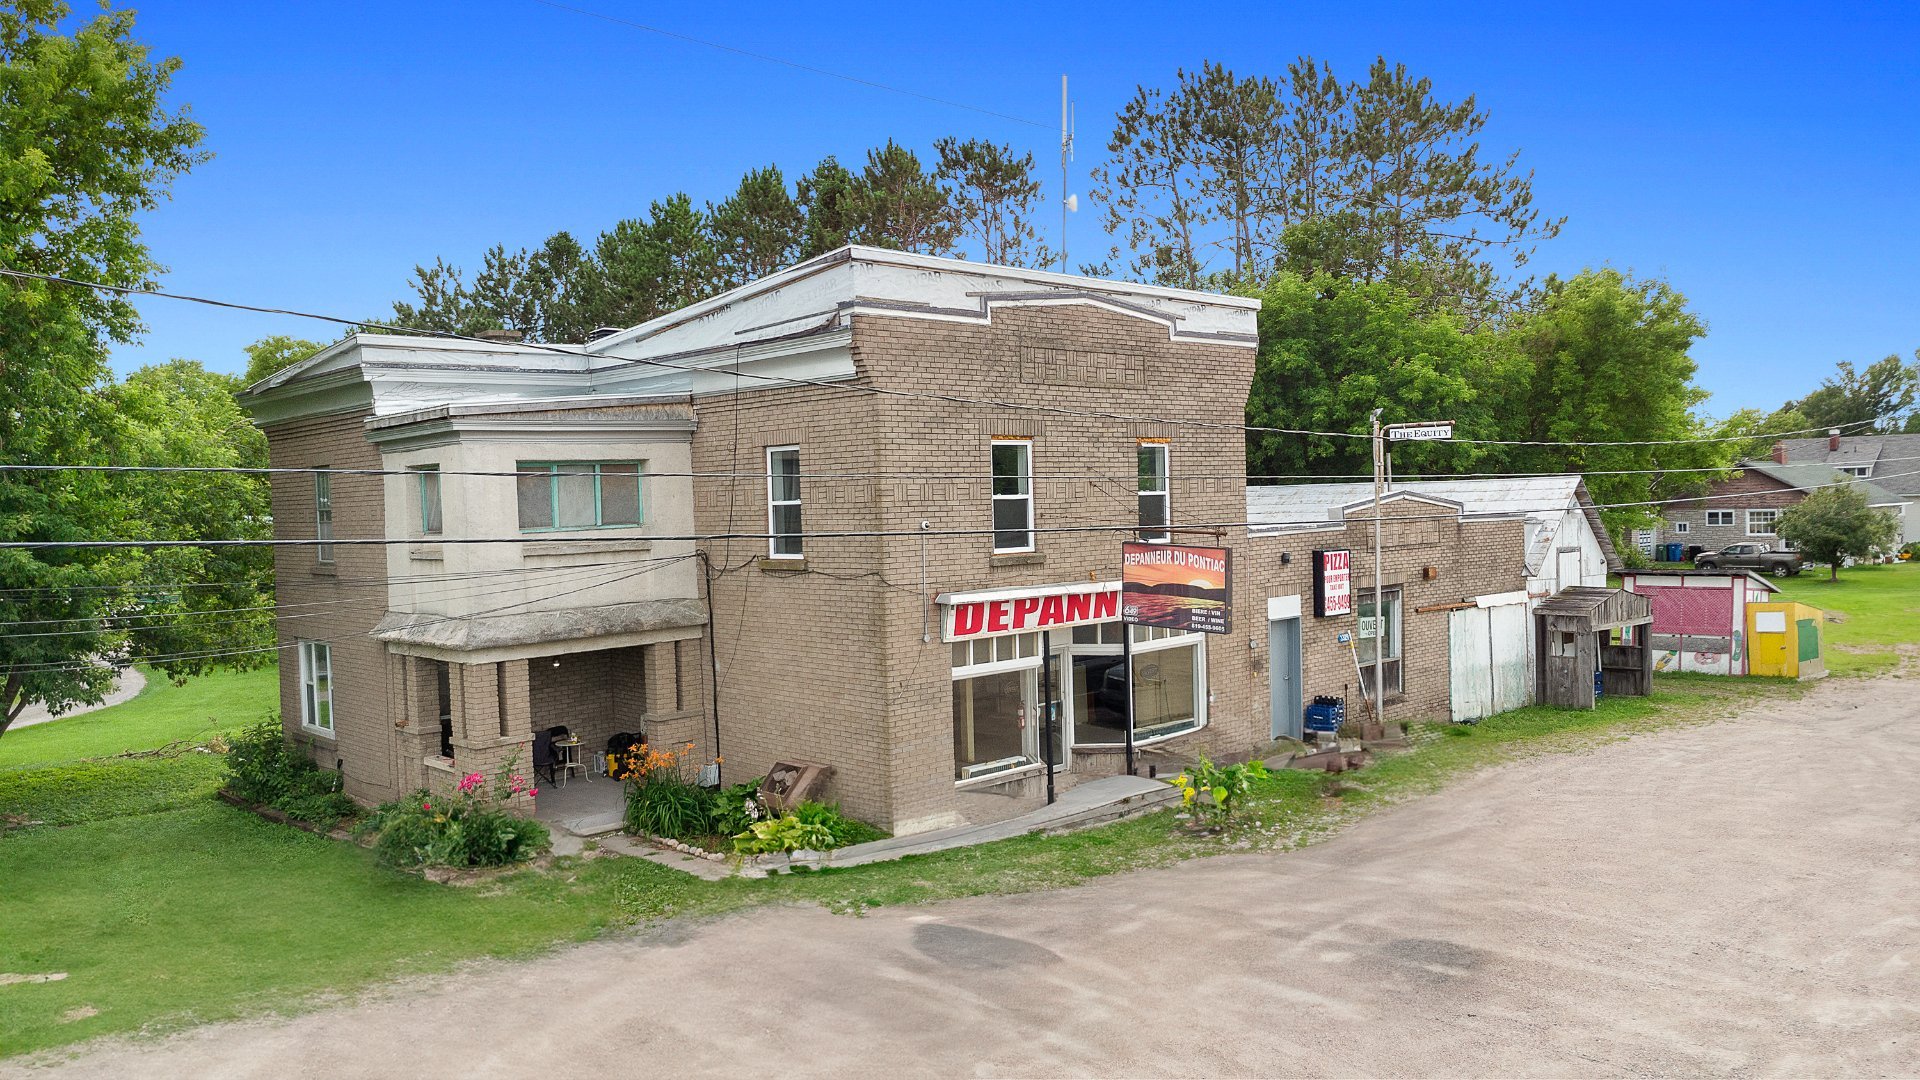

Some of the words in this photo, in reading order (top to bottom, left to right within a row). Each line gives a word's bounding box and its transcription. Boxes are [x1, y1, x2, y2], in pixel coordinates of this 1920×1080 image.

[1414, 429, 1450, 438] EQUITY
[1124, 550, 1172, 565] DEPANNEUR
[1174, 550, 1186, 566] DU
[1188, 553, 1225, 573] PONTIAC
[1323, 553, 1349, 571] PIZZA
[954, 591, 1119, 636] DEPANN
[1361, 620, 1384, 631] OUVET
